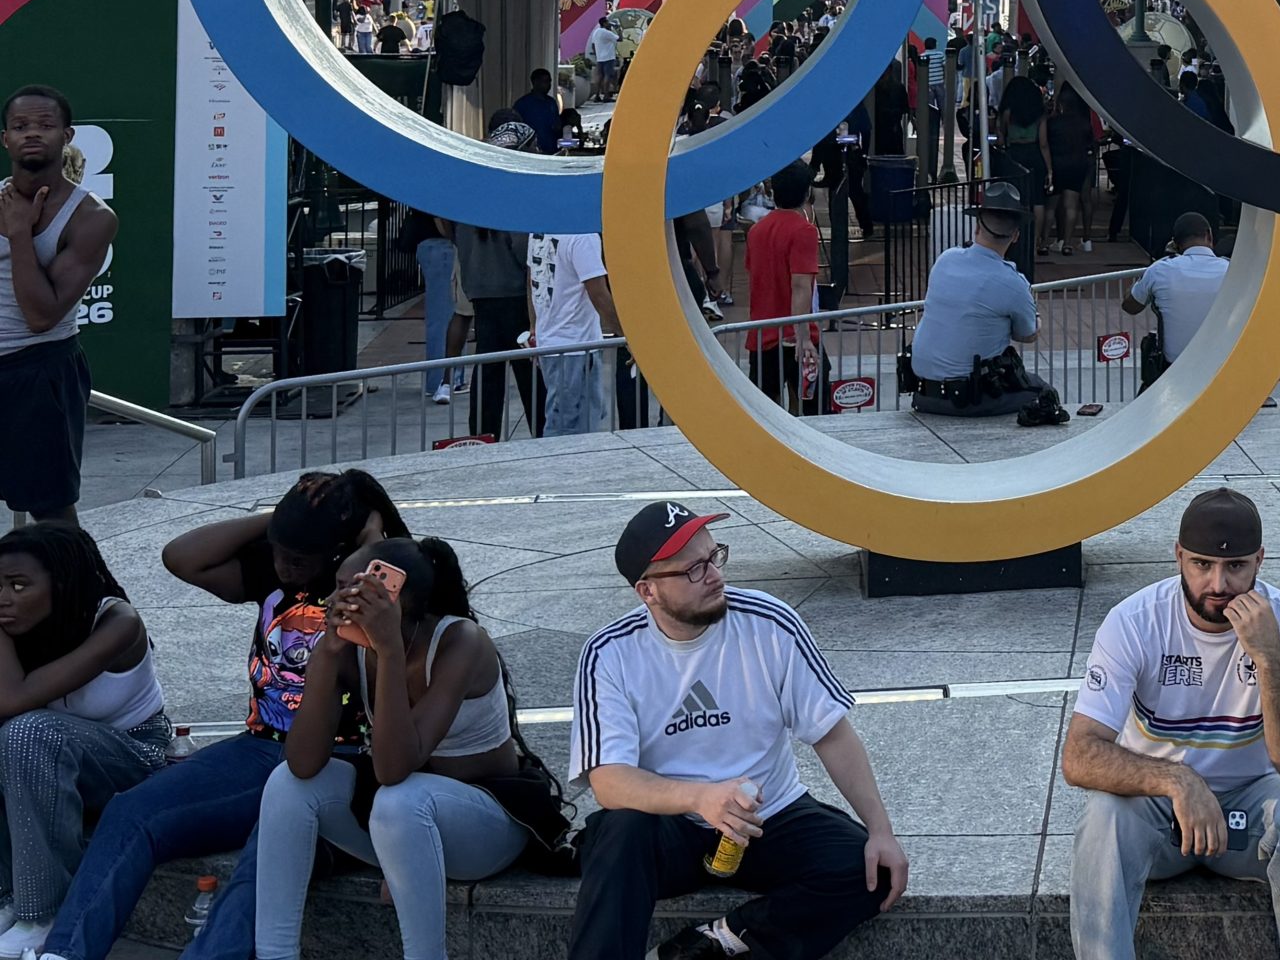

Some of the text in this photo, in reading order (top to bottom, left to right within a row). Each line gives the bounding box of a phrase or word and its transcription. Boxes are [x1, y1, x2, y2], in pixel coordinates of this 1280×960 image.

[665, 502, 689, 528] A
[1159, 665, 1203, 686] ERE
[665, 709, 731, 736] adidas
